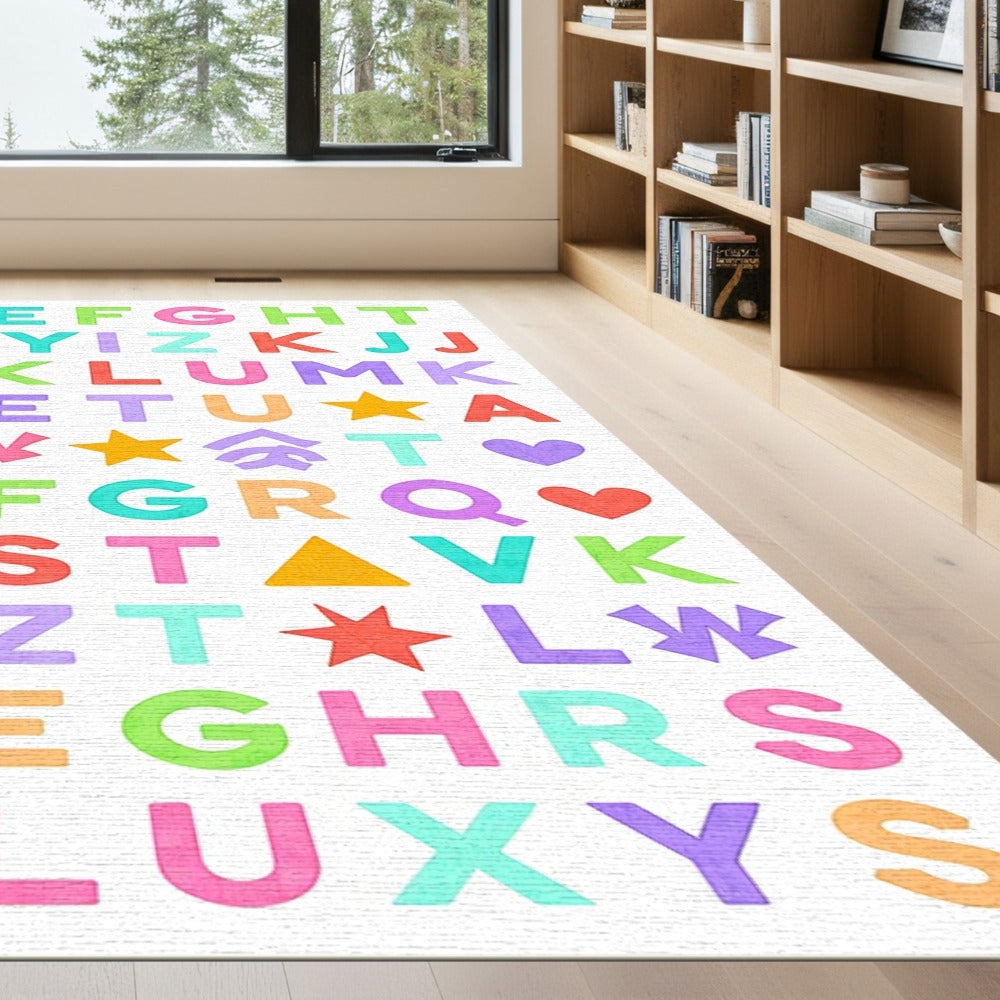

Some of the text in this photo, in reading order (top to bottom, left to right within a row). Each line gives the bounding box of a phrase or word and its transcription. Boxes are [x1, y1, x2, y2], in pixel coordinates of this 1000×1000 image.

[76, 307, 131, 324] F
[155, 307, 234, 325] G
[261, 307, 343, 324] H
[358, 307, 427, 325] T
[2, 332, 78, 353] Y
[97, 332, 120, 353] I
[148, 332, 216, 352] Z
[249, 332, 338, 353] K
[366, 332, 409, 353] J
[436, 332, 478, 353] J
[89, 361, 161, 385] L
[186, 361, 267, 385] U
[293, 362, 402, 384] M
[417, 361, 518, 385] K
[86, 394, 173, 422] T
[203, 395, 292, 422] U
[464, 394, 559, 422] A
[344, 433, 442, 466] T
[88, 479, 208, 520] G
[238, 480, 347, 519] R
[381, 480, 526, 526] Q
[106, 536, 219, 584] T
[410, 536, 535, 584] V
[575, 536, 736, 584] K
[116, 605, 242, 664] T
[482, 605, 630, 664] L
[121, 690, 289, 770] G
[319, 691, 499, 767] H
[520, 691, 703, 766] R
[724, 689, 902, 770] S
[149, 803, 321, 907] U
[360, 803, 593, 905] X
[588, 803, 768, 904] Y
[832, 799, 1000, 909] S
